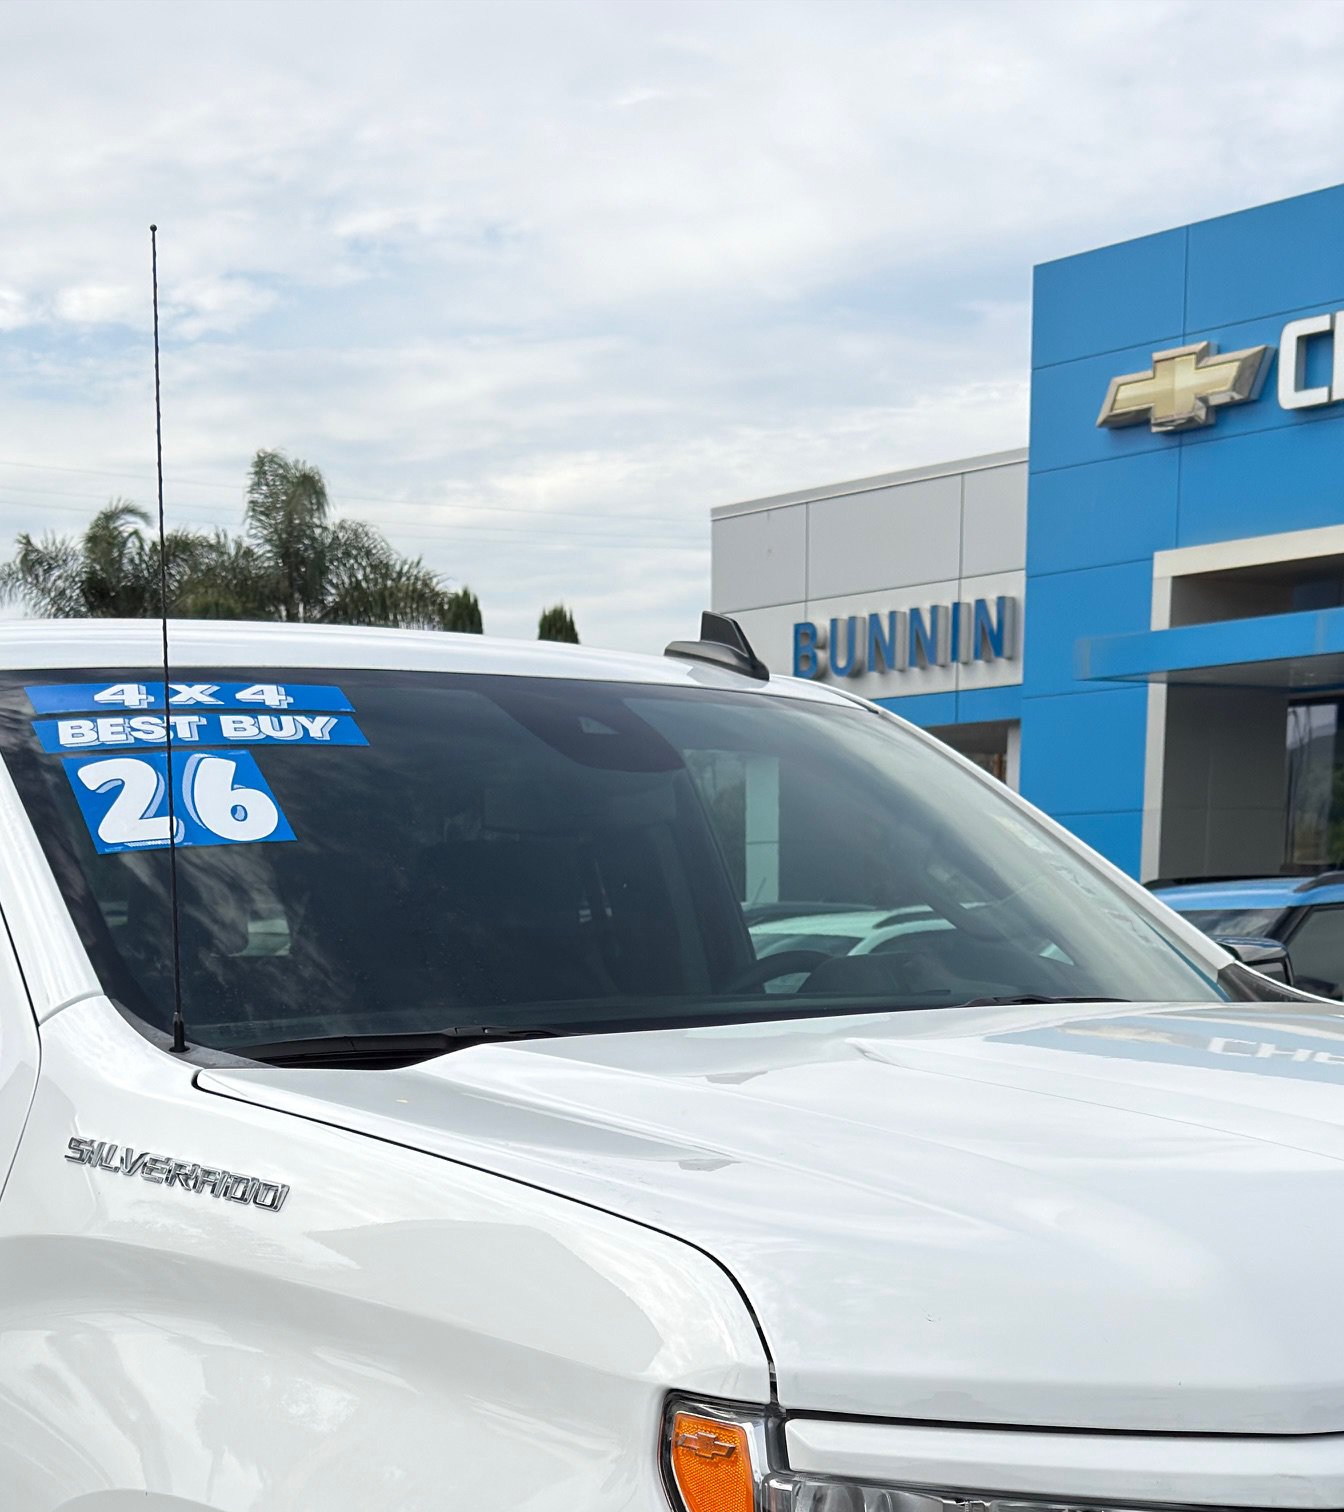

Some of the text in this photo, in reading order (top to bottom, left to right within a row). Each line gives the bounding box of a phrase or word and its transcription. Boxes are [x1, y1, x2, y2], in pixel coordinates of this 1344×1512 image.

[793, 596, 1015, 680] BUNNIN
[57, 715, 338, 748] BEST BUY
[77, 753, 279, 846] 26
[64, 1136, 290, 1212] SILVERADO
